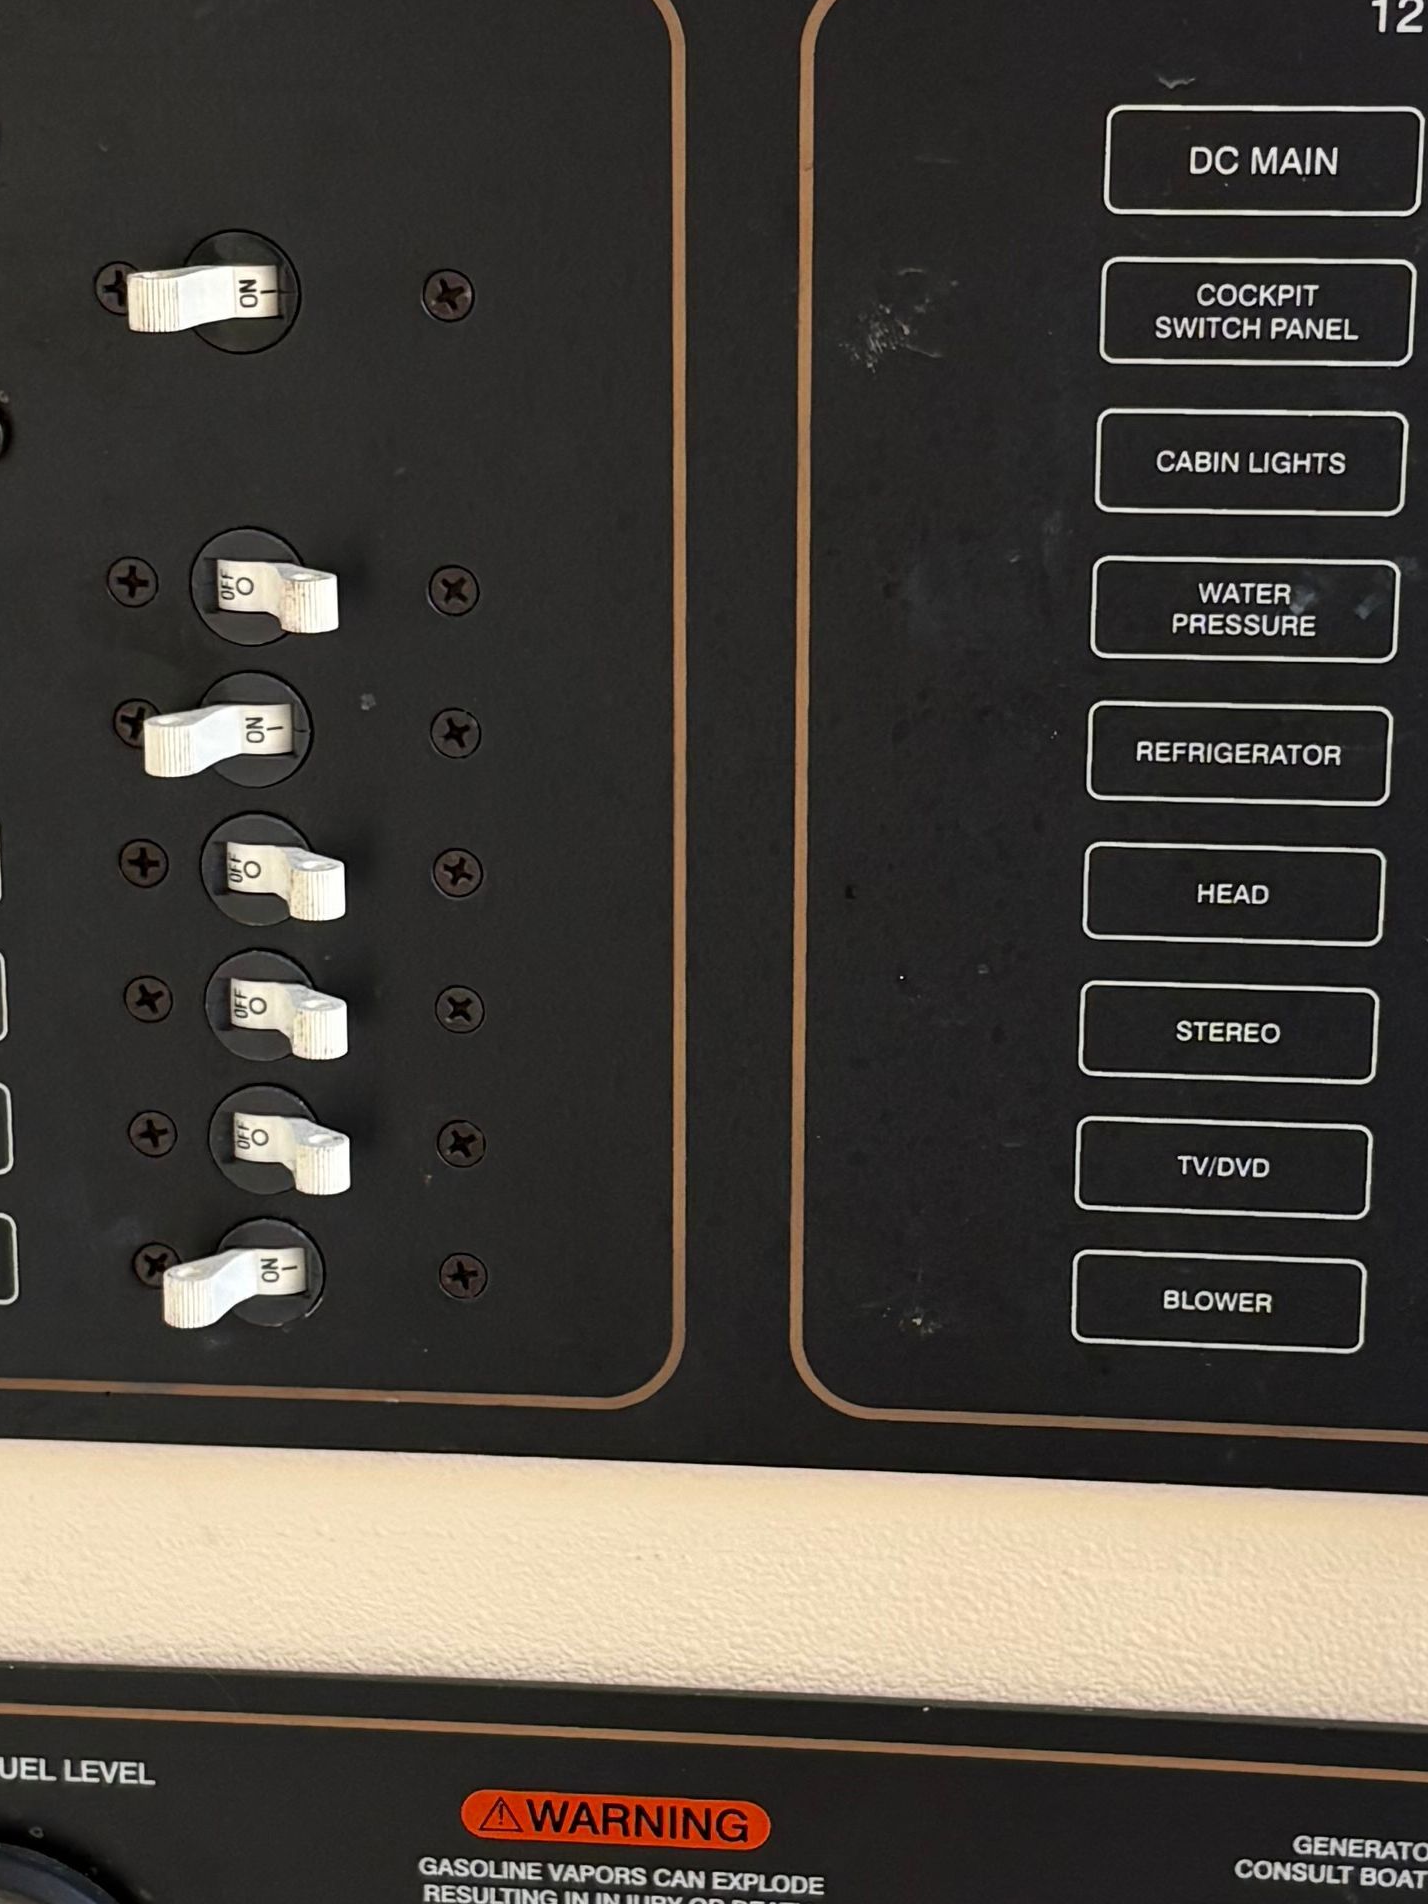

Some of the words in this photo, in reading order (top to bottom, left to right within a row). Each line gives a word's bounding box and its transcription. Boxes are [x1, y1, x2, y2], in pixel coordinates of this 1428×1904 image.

[1190, 146, 1238, 174] DC
[1251, 147, 1337, 174] MAIN
[1197, 284, 1319, 306] COCKPIT
[1156, 316, 1260, 339] SWITCH
[1271, 318, 1358, 340] PANEL
[1157, 451, 1239, 472] CABIN
[1249, 452, 1345, 474] LIGHTS
[1199, 583, 1291, 604] WATER
[1173, 614, 1315, 636] PRESSURE
[1137, 741, 1341, 765] REFRIGERATOR
[1198, 884, 1268, 904] HEAD
[1177, 1021, 1280, 1043] STEREO
[1178, 1156, 1269, 1177] TV/DVD
[1164, 1290, 1272, 1313] BLOWER
[64, 1760, 155, 1785] LEVEL
[526, 1798, 748, 1843] WARNING
[419, 1857, 542, 1880] GASOLINE
[548, 1864, 647, 1886] VAPORS
[653, 1869, 705, 1888] CAN
[712, 1872, 824, 1895] EXPLODE
[1235, 1859, 1354, 1884] CONSULT
[1361, 1868, 1428, 1888] BOAT
